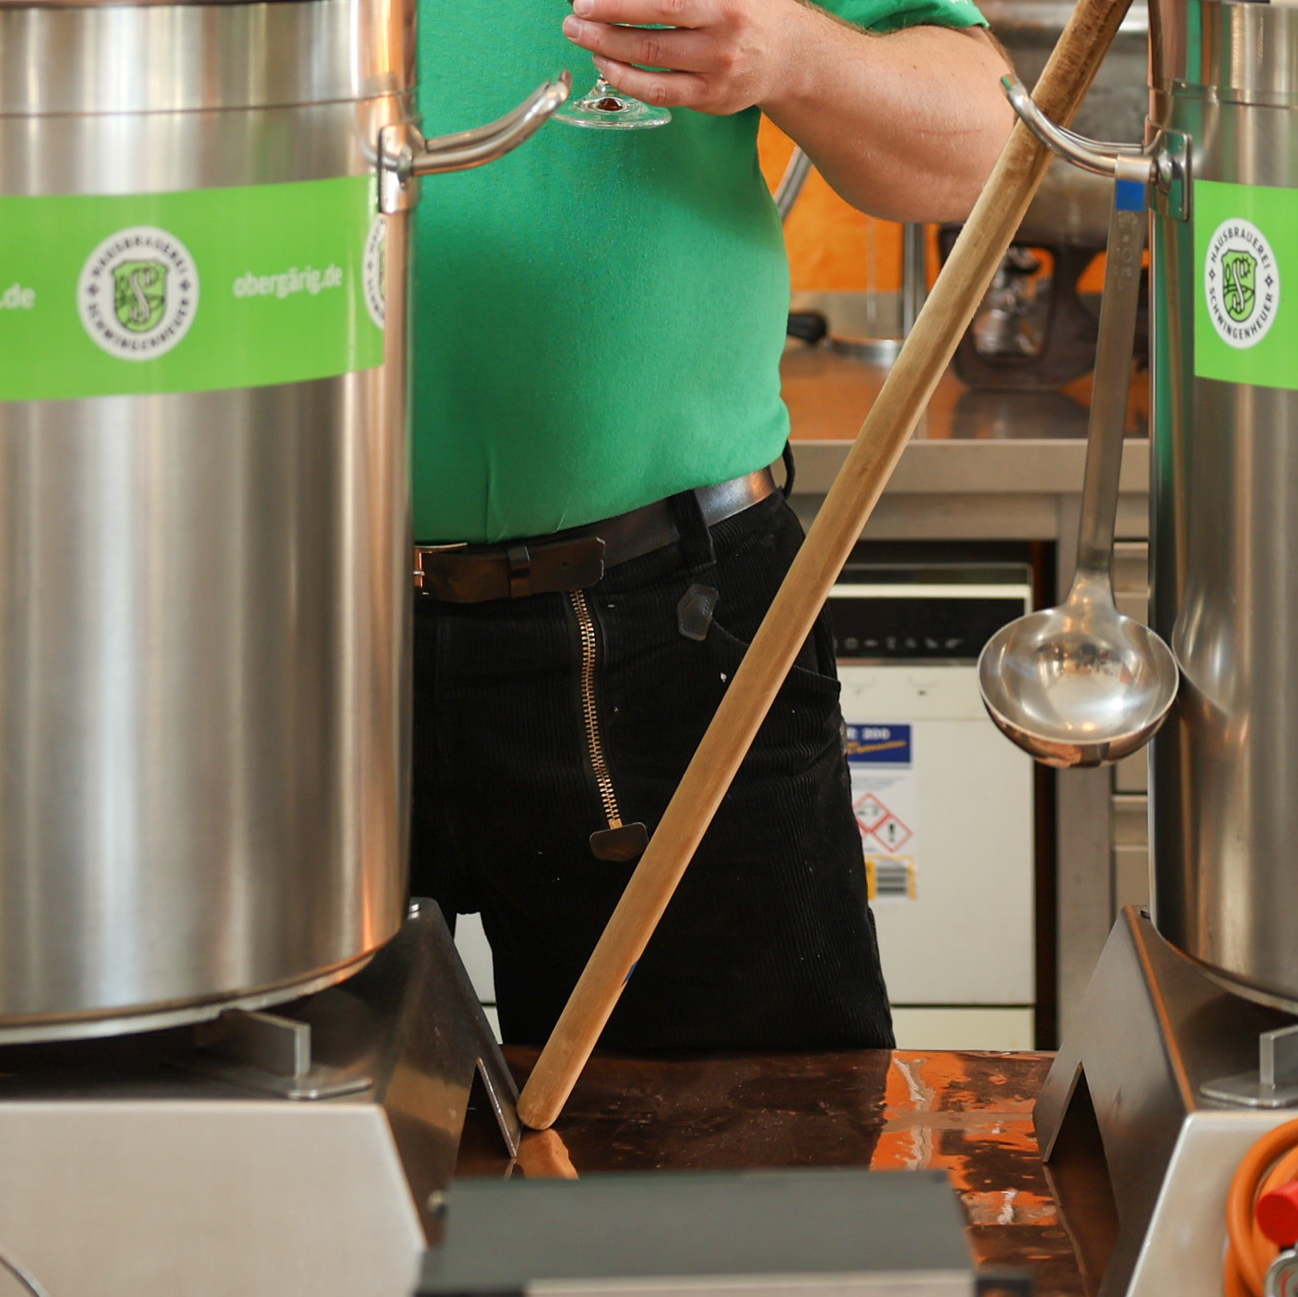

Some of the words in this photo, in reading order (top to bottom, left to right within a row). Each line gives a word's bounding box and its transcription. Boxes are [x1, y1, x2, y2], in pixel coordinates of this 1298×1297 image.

[1210, 225, 1272, 270] HAUSBRAUEREI
[232, 262, 344, 302] obergärig.de
[1208, 286, 1274, 341] SCHWINGENHEUER
